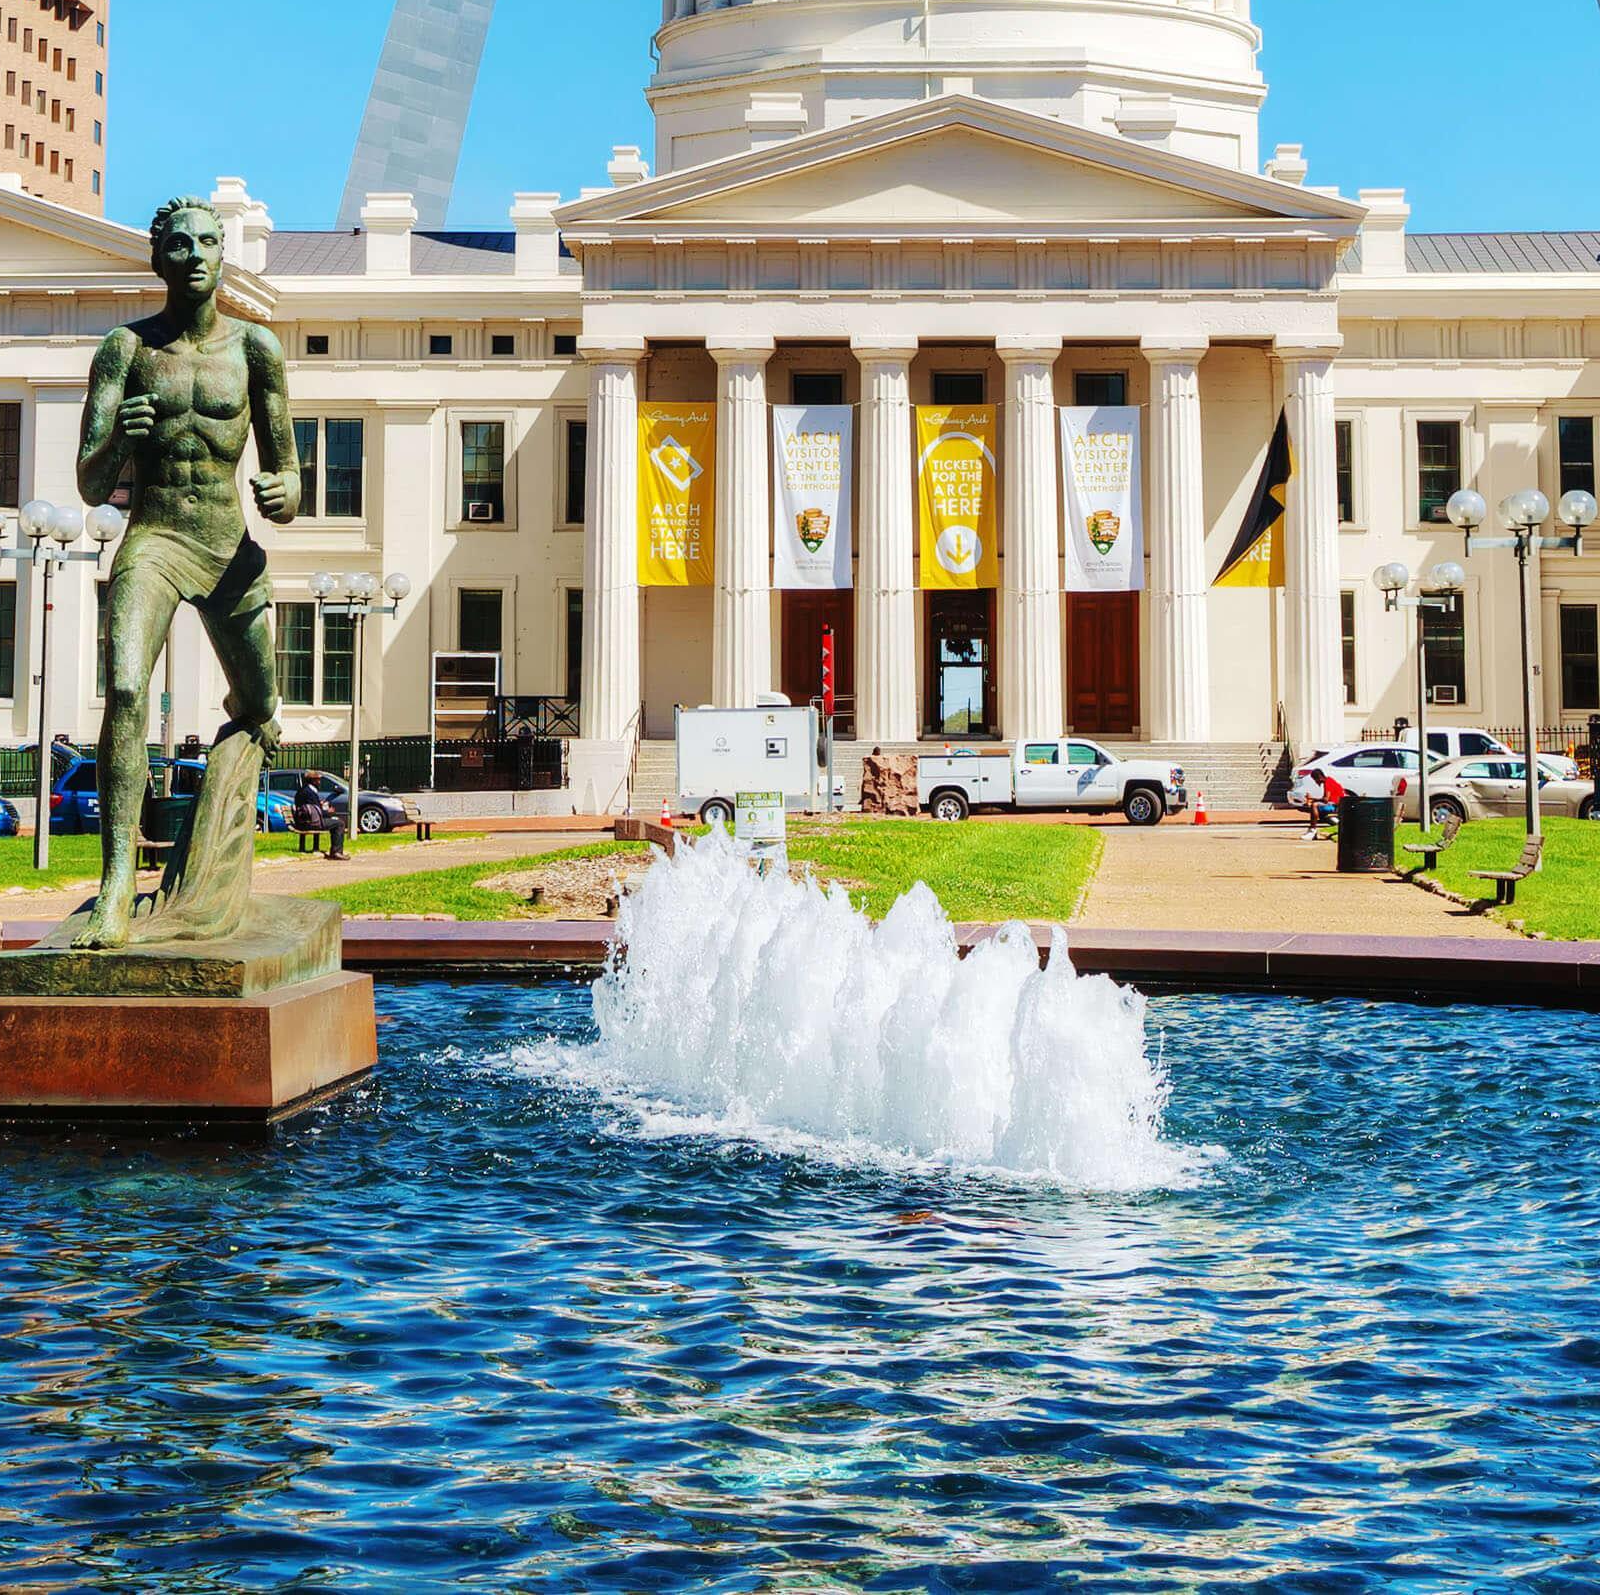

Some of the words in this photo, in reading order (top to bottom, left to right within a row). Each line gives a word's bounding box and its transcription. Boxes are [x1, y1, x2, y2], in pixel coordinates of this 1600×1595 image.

[785, 431, 841, 445] ARCH
[1074, 433, 1129, 447] ARCH
[785, 448, 840, 458] VISITOR
[1074, 450, 1128, 460] VISITOR
[785, 461, 840, 471] CENTER
[932, 460, 982, 470] TICKETS
[1074, 463, 1129, 473] CENTER
[932, 471, 957, 482] FOR
[960, 471, 982, 482] THE
[933, 484, 982, 496] ARCH
[651, 503, 701, 516] ARCH
[933, 498, 982, 516] HERE
[650, 528, 700, 540] STARTS
[650, 541, 700, 560] HERE
